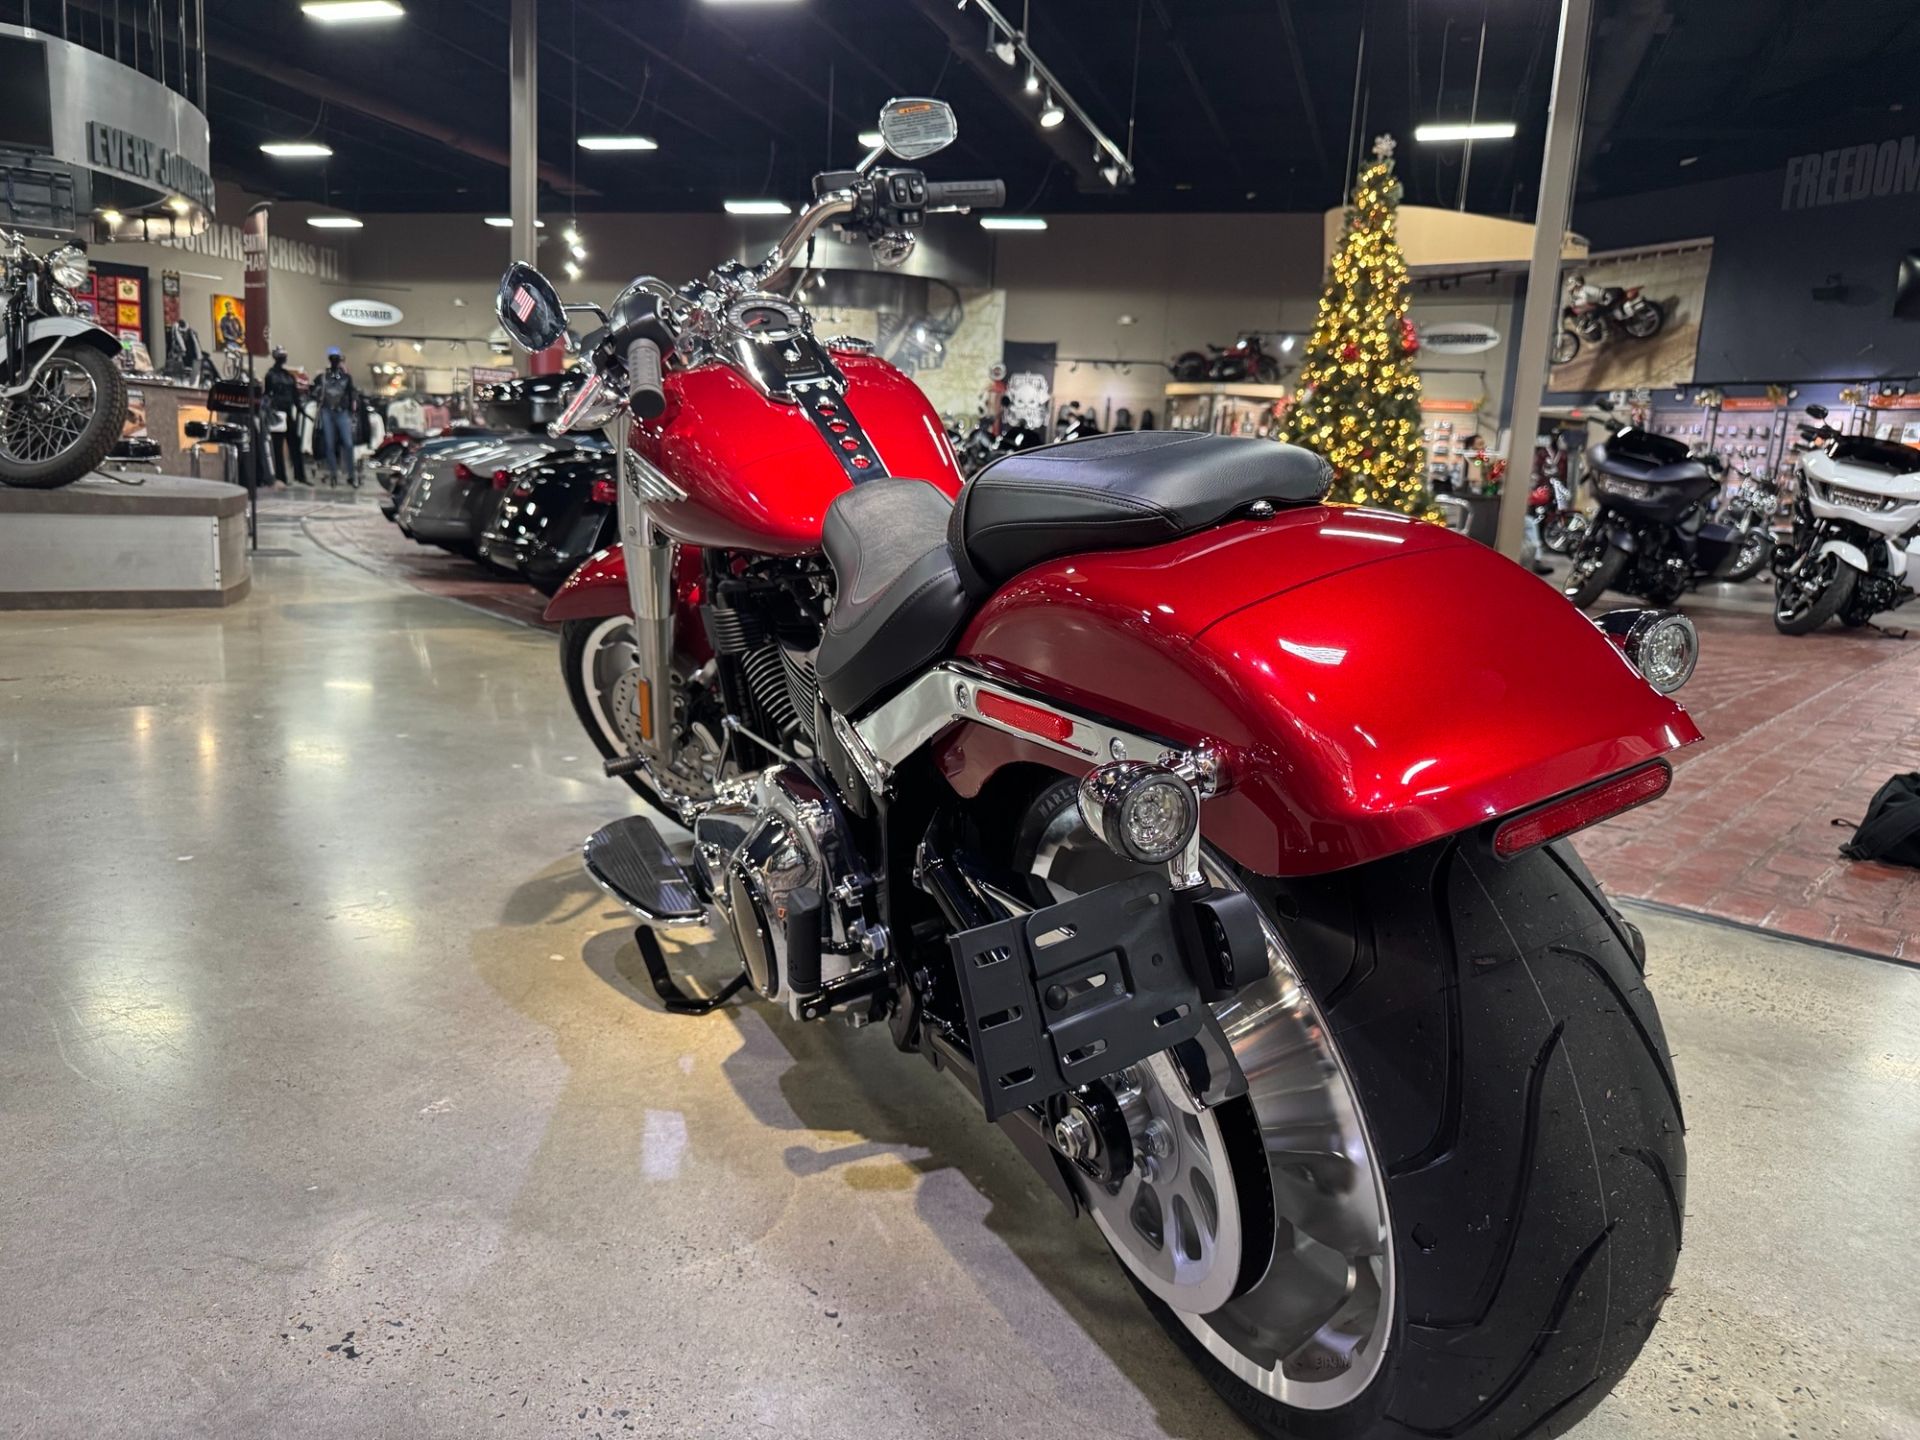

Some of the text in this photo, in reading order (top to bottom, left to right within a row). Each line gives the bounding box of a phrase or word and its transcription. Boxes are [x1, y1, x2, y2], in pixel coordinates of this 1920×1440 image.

[87, 120, 158, 179] EVERY
[269, 235, 316, 275] CROSS
[1038, 785, 1077, 817] HARLE
